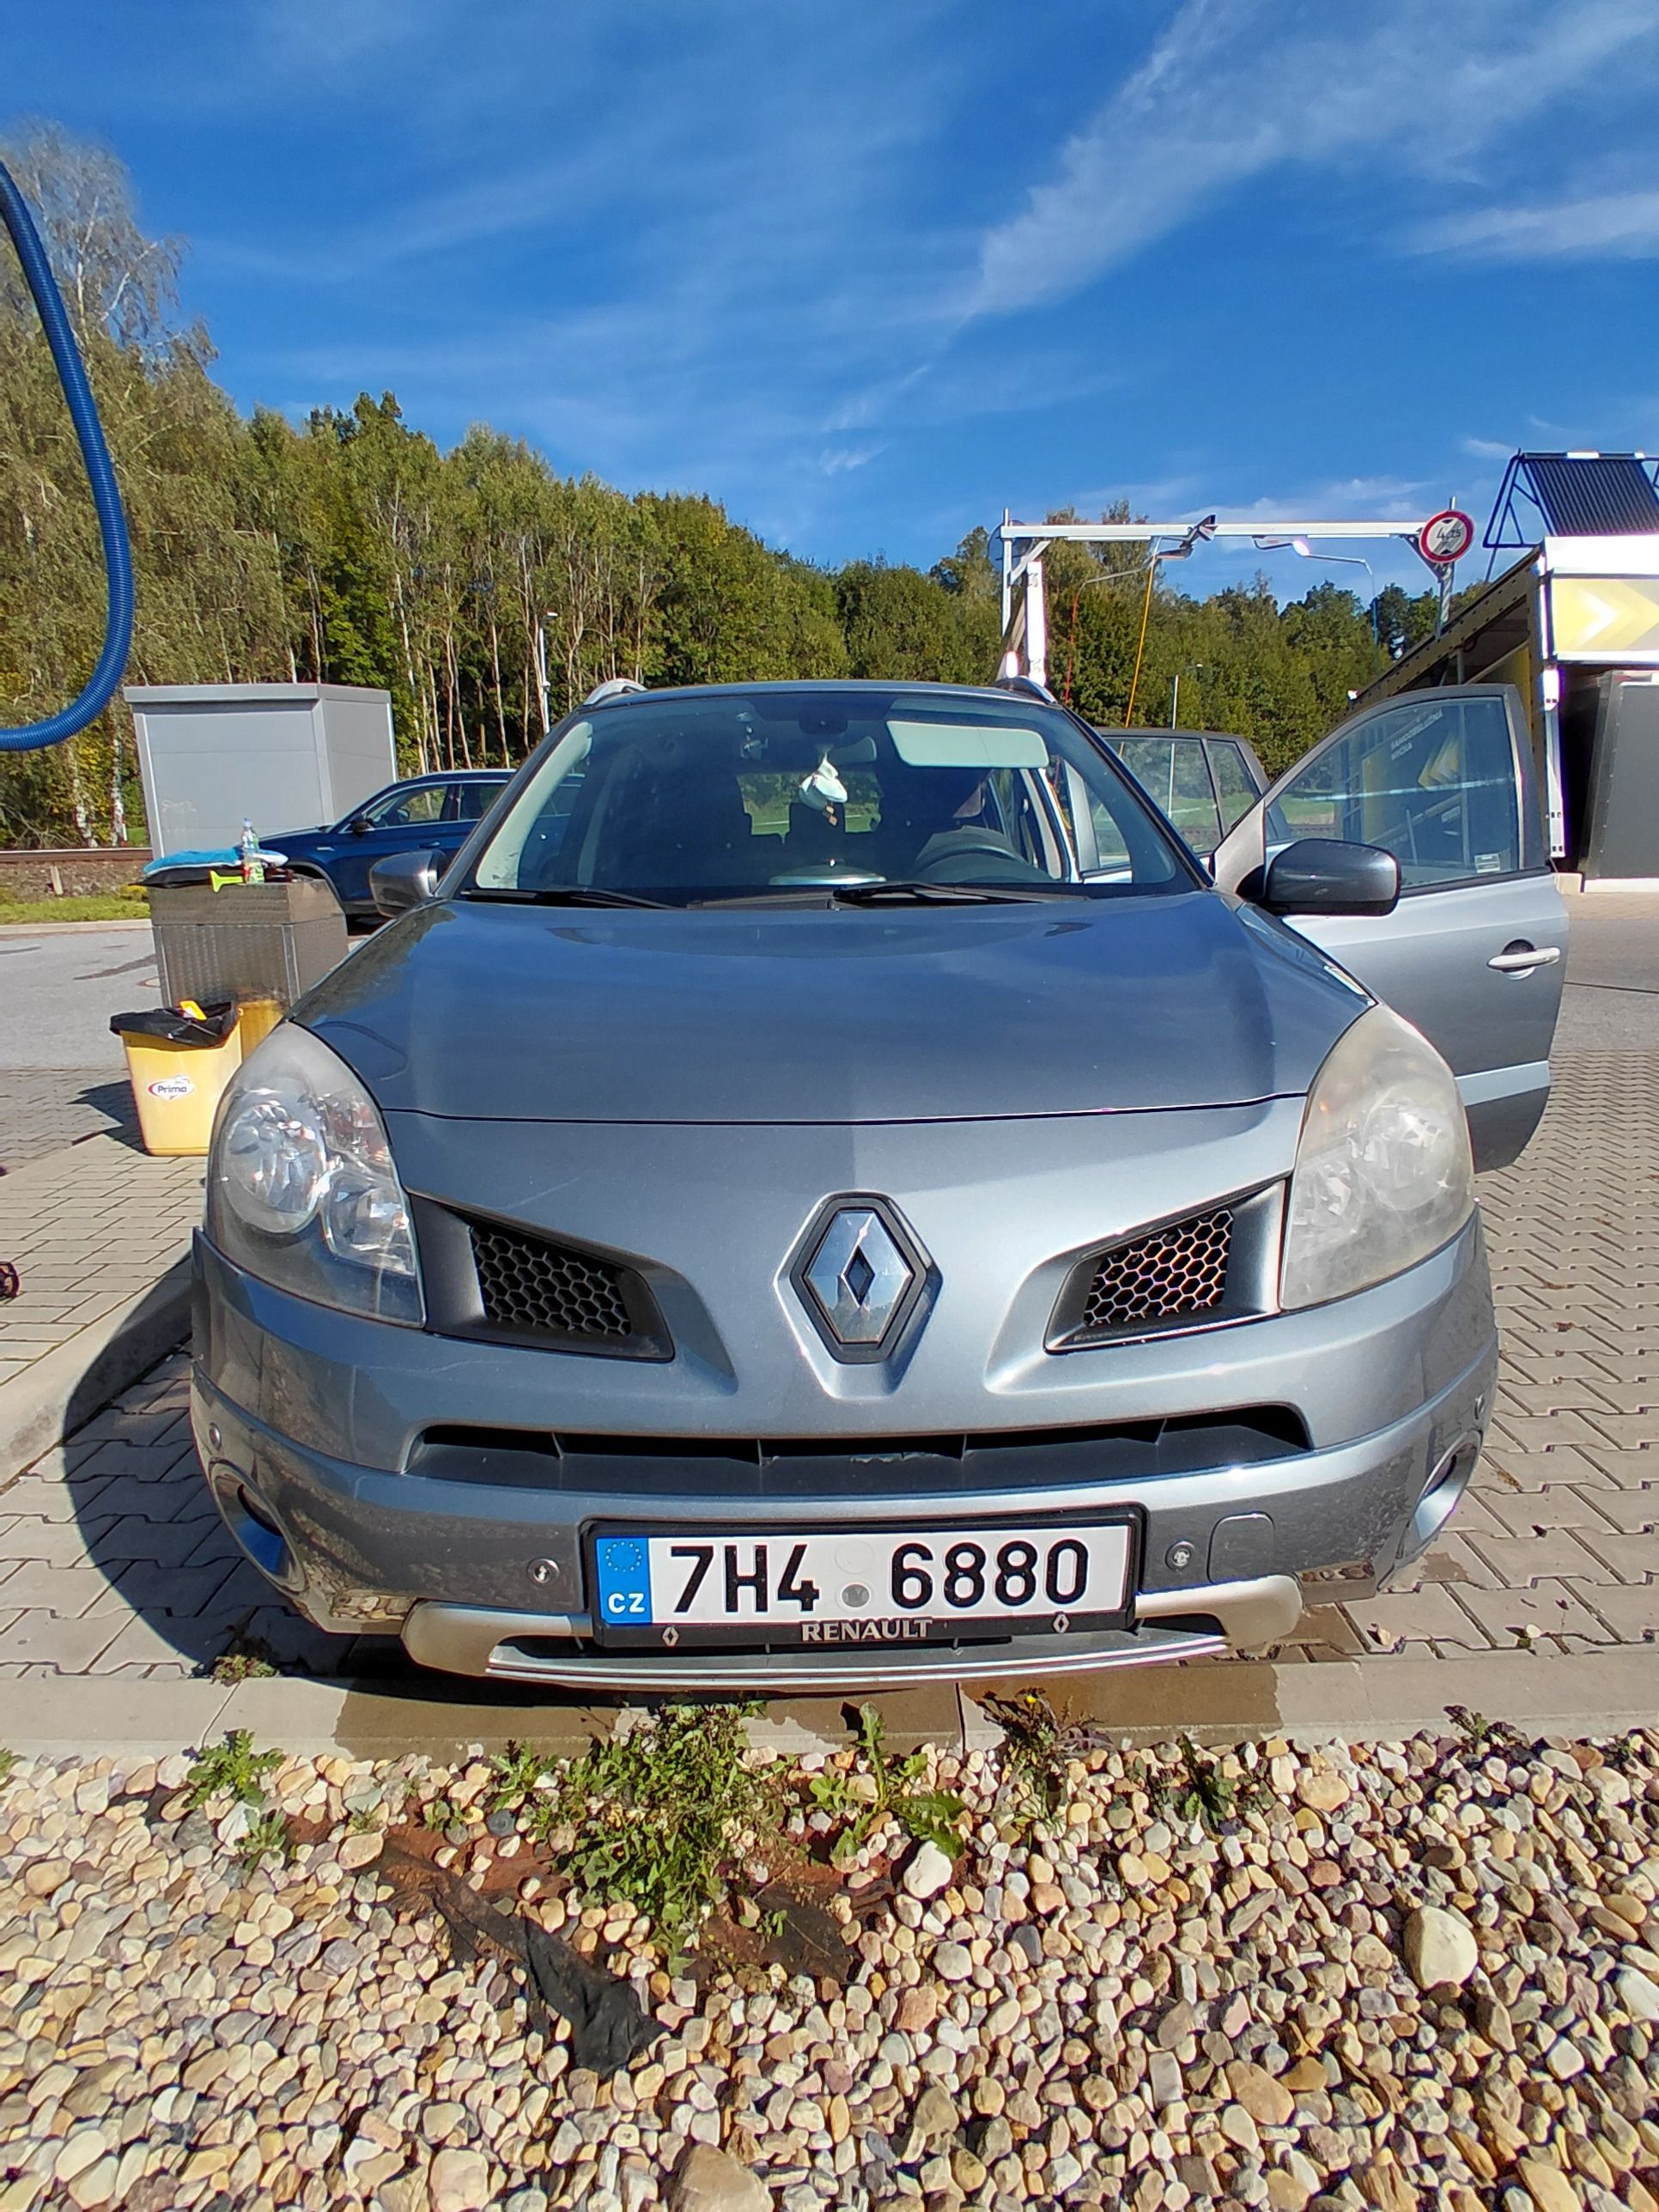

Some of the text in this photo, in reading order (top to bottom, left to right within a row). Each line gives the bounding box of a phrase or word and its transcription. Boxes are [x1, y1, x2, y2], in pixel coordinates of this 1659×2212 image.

[157, 1085, 187, 1094] Prima
[671, 1539, 1089, 1613] 7H4 6880
[608, 1593, 645, 1613] CZ
[801, 1619, 933, 1642] RENAULT
